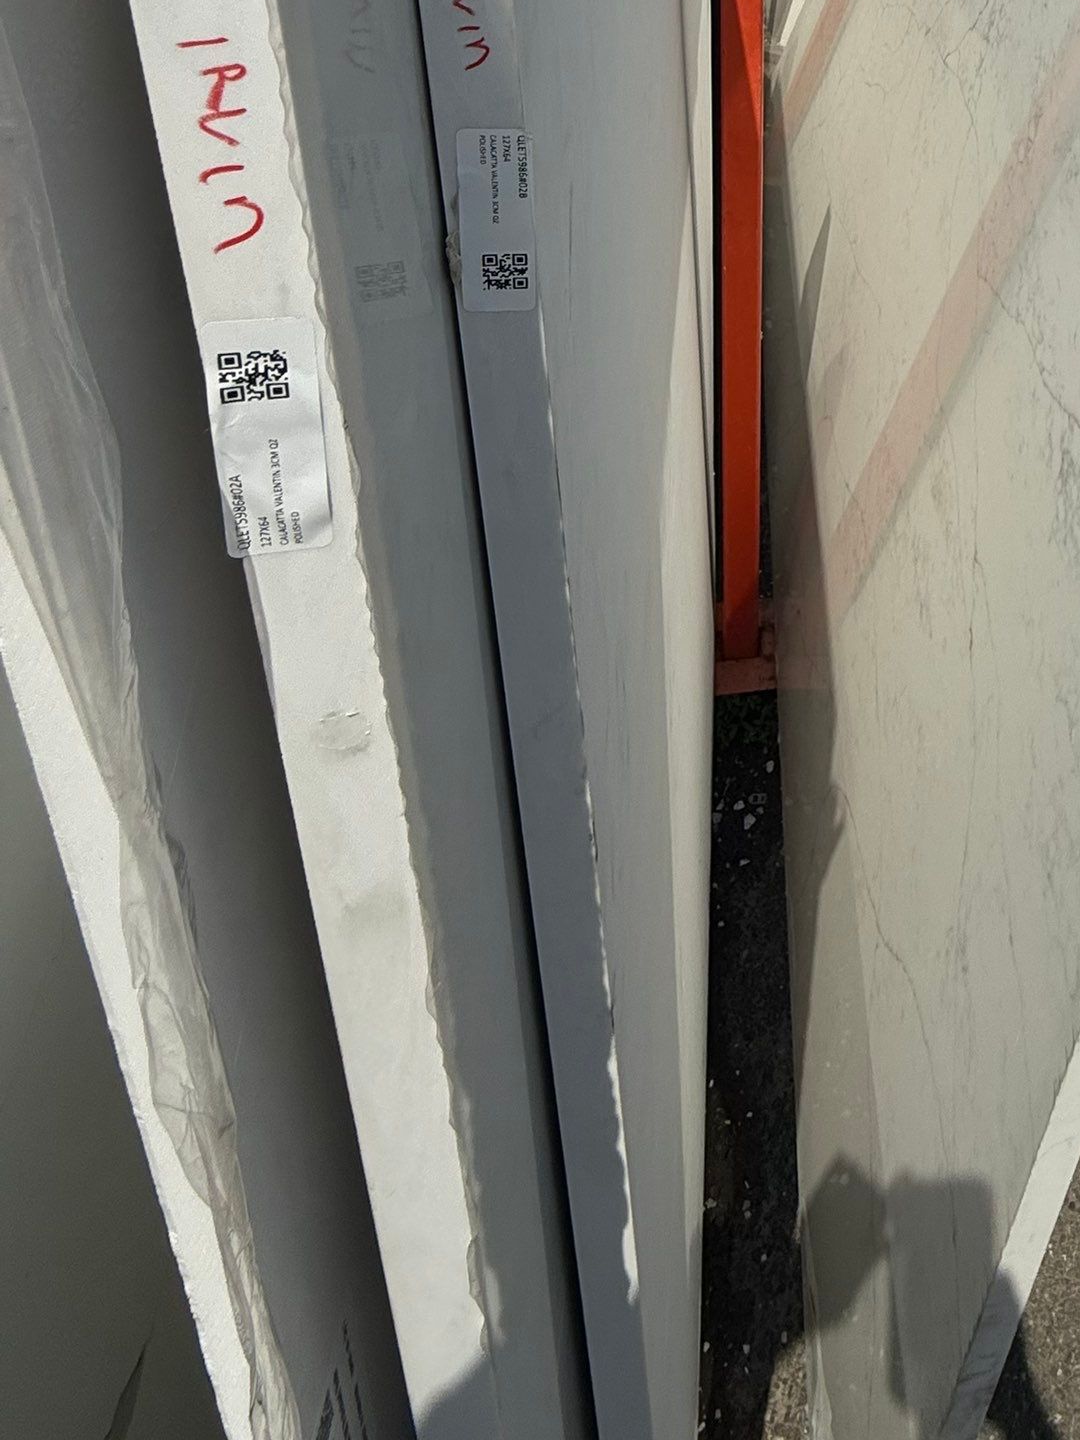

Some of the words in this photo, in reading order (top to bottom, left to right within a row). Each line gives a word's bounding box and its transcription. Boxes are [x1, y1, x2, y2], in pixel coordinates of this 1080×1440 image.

[489, 134, 498, 169] CALACATTA
[502, 135, 512, 163] 127X64
[490, 170, 499, 200] VALENTIN
[491, 200, 500, 215] 3CM
[270, 450, 281, 469] 3CM
[271, 469, 285, 507] VALENTIN
[257, 516, 273, 548] 127X64
[274, 507, 290, 547] CALACATTA
